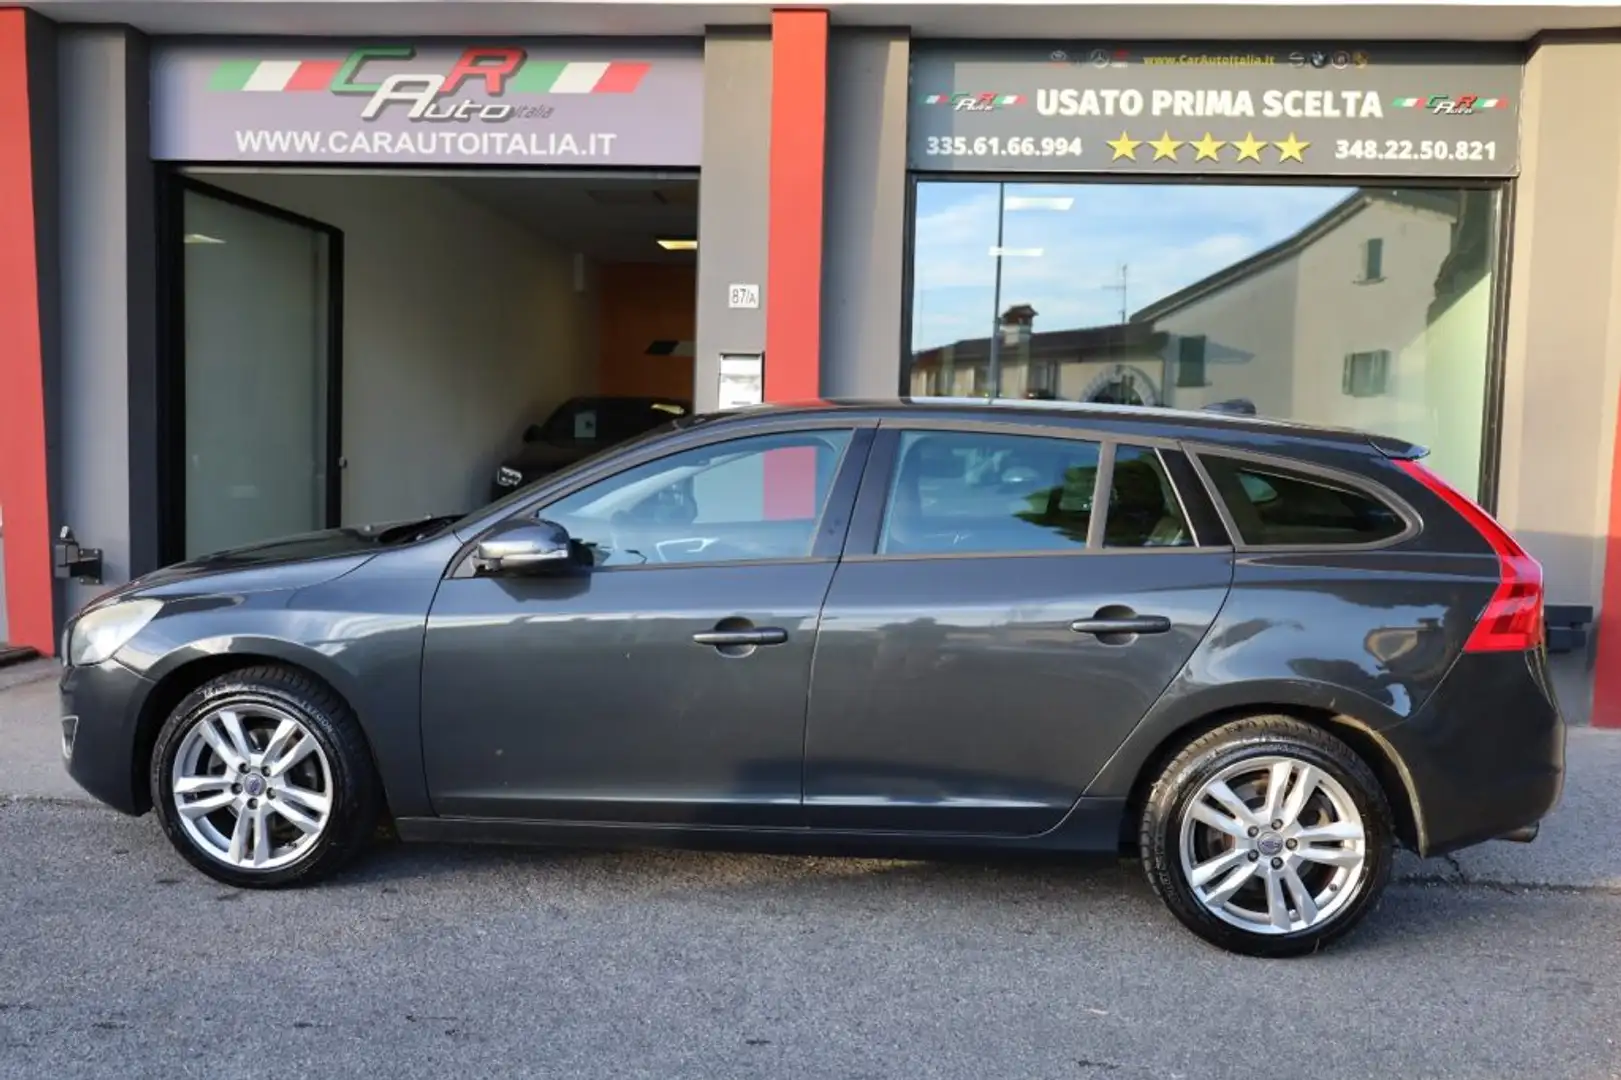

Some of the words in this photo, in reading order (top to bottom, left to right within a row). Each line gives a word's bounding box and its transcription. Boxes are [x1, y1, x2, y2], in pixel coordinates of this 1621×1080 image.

[1036, 88, 1144, 117] USATO
[1151, 89, 1255, 118] PRIMA
[1262, 90, 1384, 119] SCELTA
[235, 130, 617, 157] WWW.CARAUTOITALIA.IT
[926, 136, 1083, 157] 335.61.66.994
[1335, 139, 1497, 161] 348.22.50.821
[731, 288, 756, 304] 87/A
